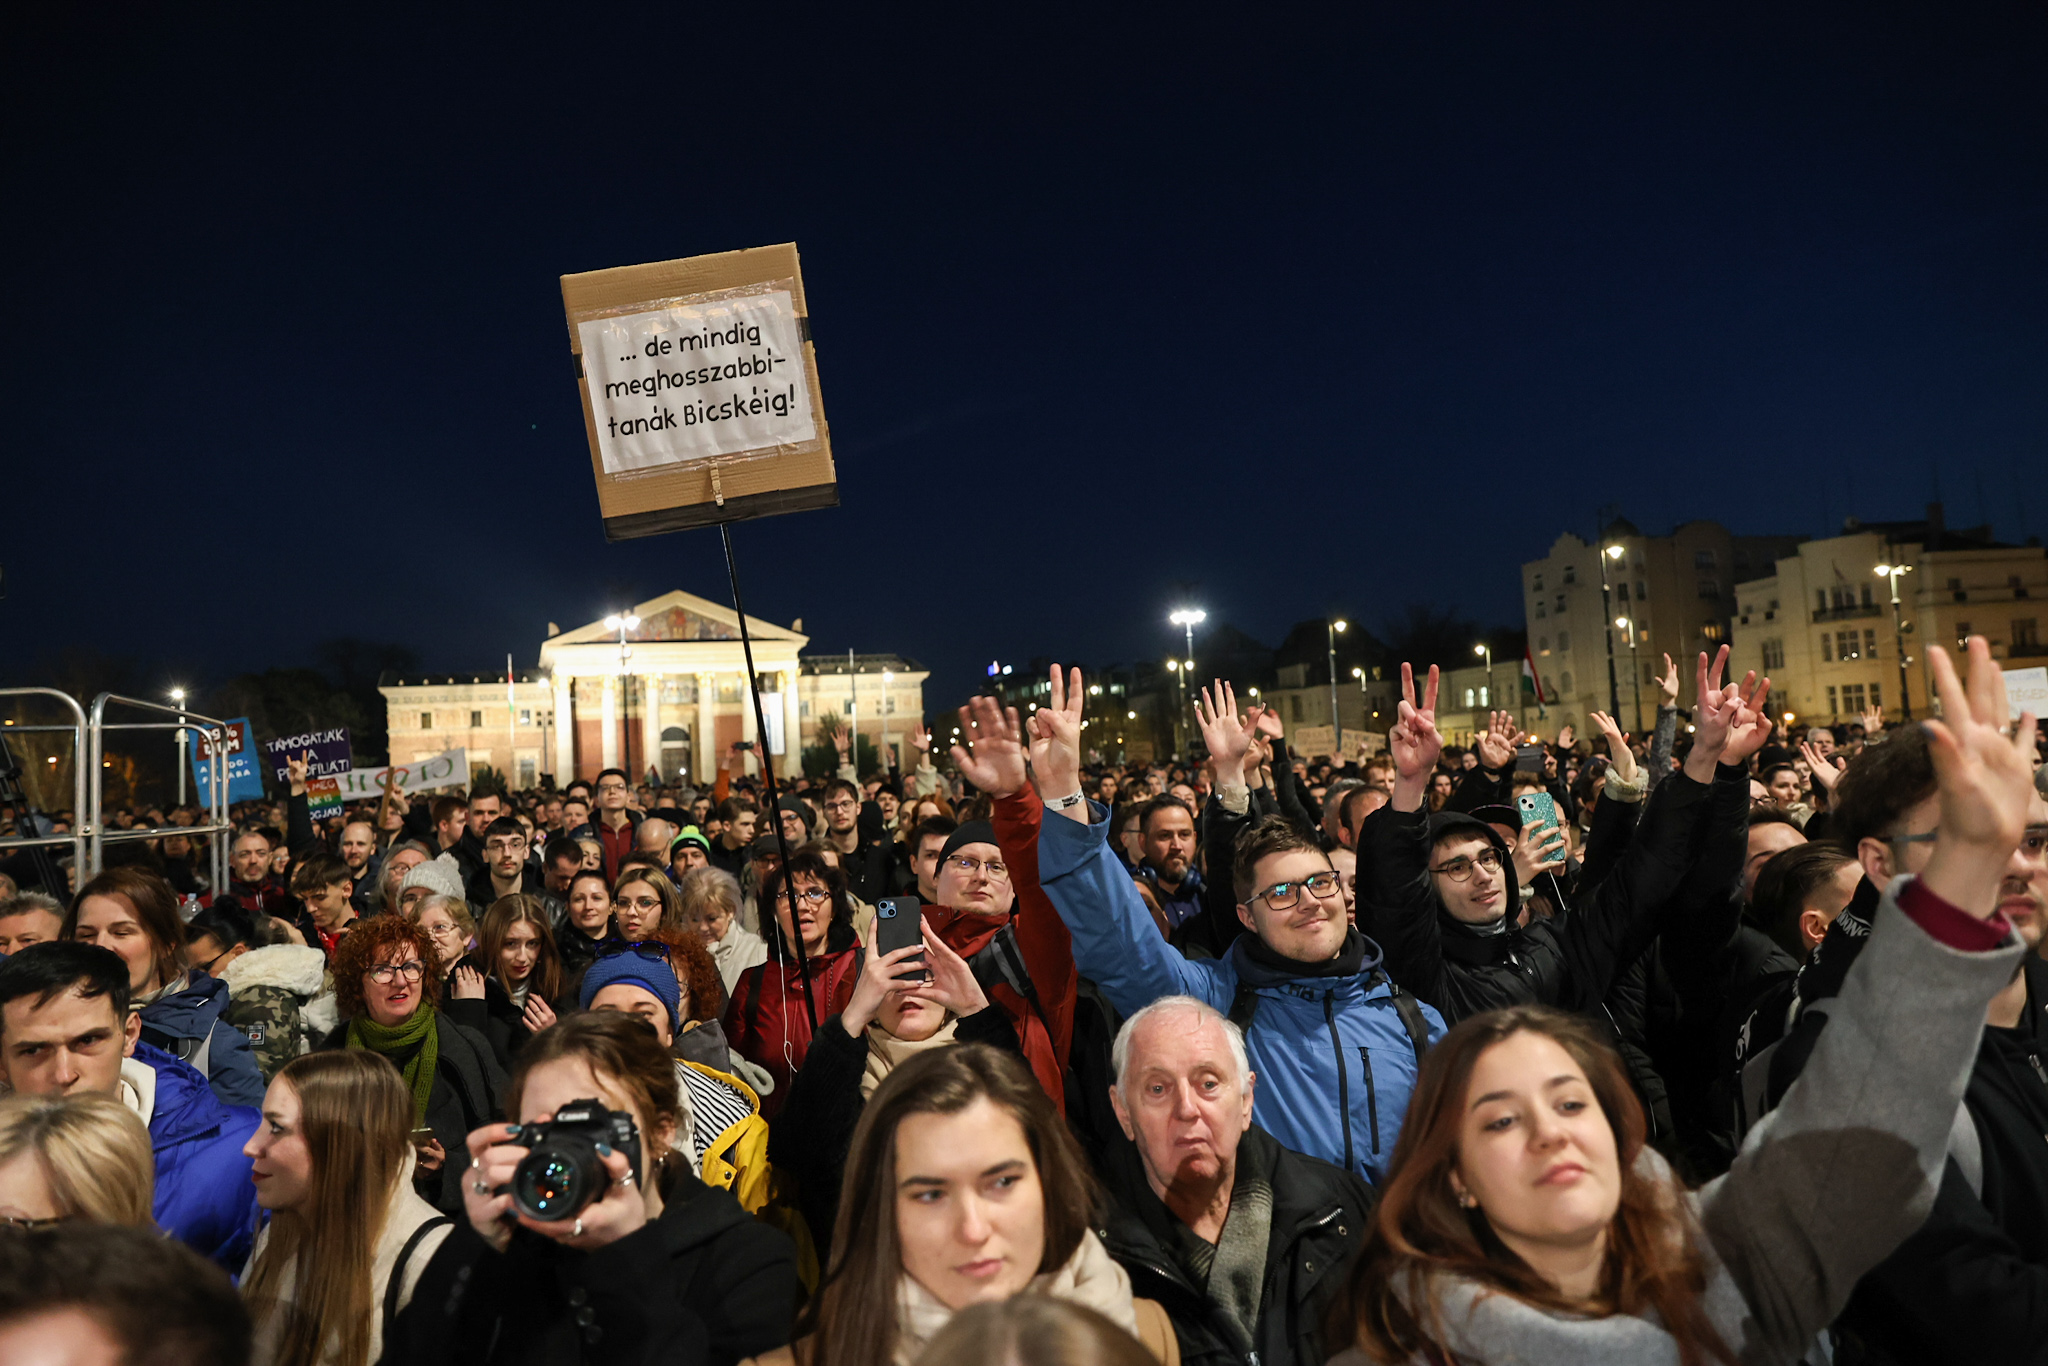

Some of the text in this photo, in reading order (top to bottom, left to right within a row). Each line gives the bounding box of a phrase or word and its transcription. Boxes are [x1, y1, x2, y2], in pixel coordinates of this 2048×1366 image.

[644, 335, 672, 358] de
[679, 321, 761, 353] mindig
[608, 384, 796, 438] tanák Bicskéig!
[201, 726, 238, 742] 9%
[265, 727, 345, 753] TÁMOGATJÁK
[307, 748, 318, 760] A
[276, 759, 349, 782] POFILIÁT!
